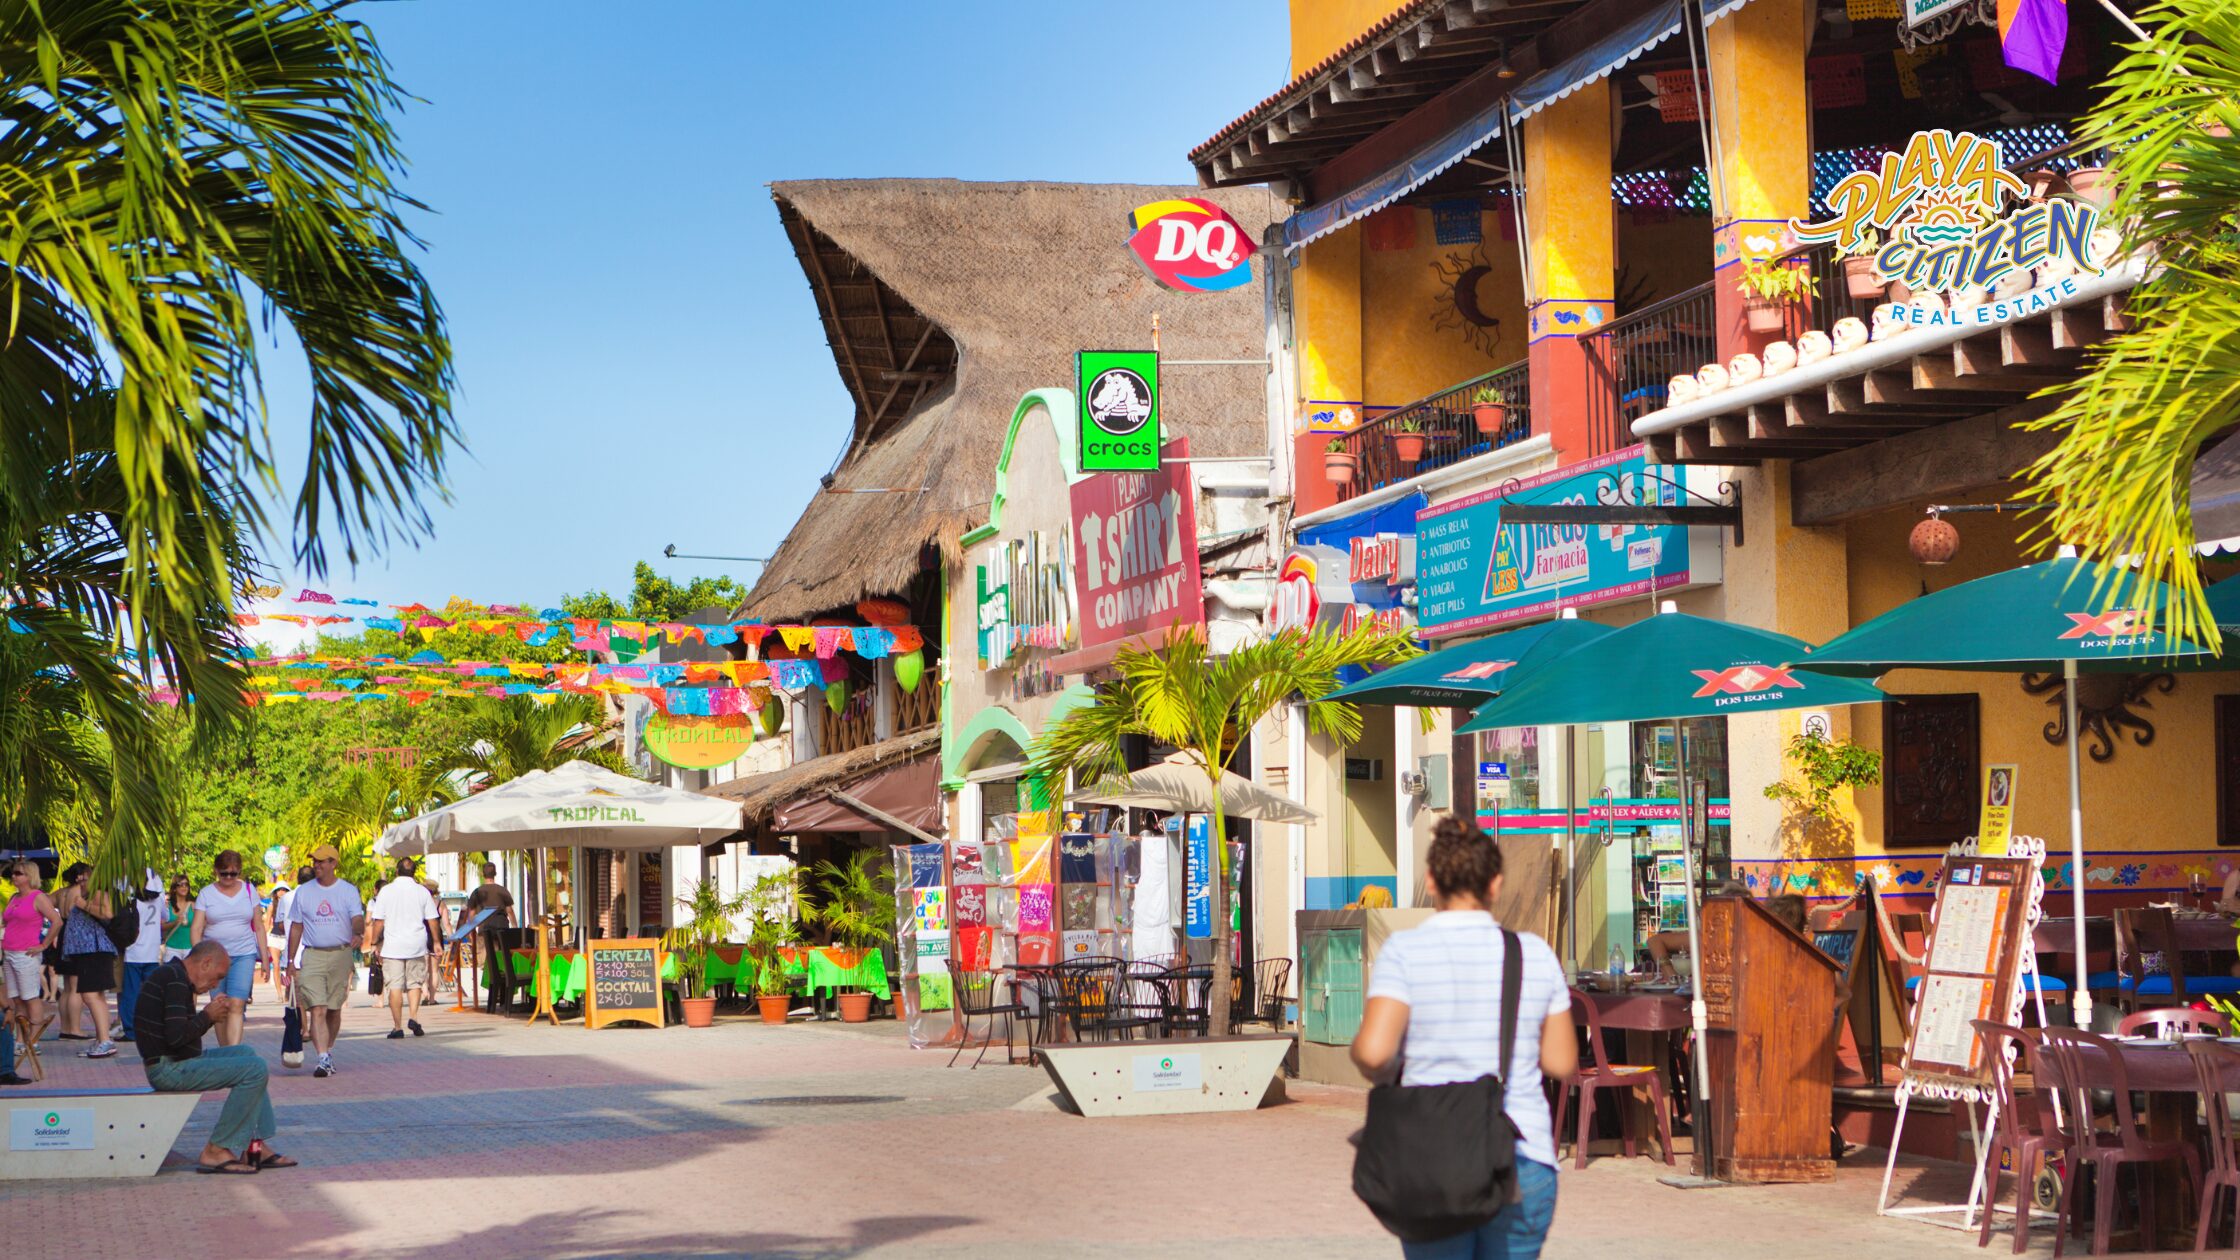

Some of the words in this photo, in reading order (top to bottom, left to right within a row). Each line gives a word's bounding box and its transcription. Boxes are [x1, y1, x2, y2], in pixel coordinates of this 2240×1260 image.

[1088, 442, 1152, 456] crocs
[1117, 474, 1147, 506] PLAYA
[1429, 524, 1447, 538] MASS
[1448, 518, 1469, 534] RELAX
[1430, 537, 1471, 558] ANTIBIOTICS
[1349, 533, 1399, 586] Dairy
[1496, 547, 1511, 568] PAY
[1536, 546, 1588, 576] Farmacia
[1430, 557, 1468, 577] ANABOLICS
[1430, 581, 1456, 597] VIAGRA
[1491, 567, 1519, 596] LESS
[1095, 572, 1182, 629] COMPANY
[1431, 602, 1446, 616] DIET
[1448, 598, 1465, 614] PILLS
[2080, 639, 2109, 648] DOS
[1715, 696, 1741, 707] DOS
[1744, 691, 1783, 703] EQUIS
[651, 726, 749, 744] TROPICAL
[548, 806, 646, 823] TROPICAL
[1638, 806, 1664, 816] ALEVE
[1187, 840, 1199, 925] infinitum
[144, 905, 156, 926] 2
[594, 949, 652, 962] CERVEZA
[932, 943, 949, 952] AVE
[630, 969, 650, 978] SOL
[595, 981, 655, 993] COCKTAIL
[34, 1128, 71, 1136] Solidaridad
